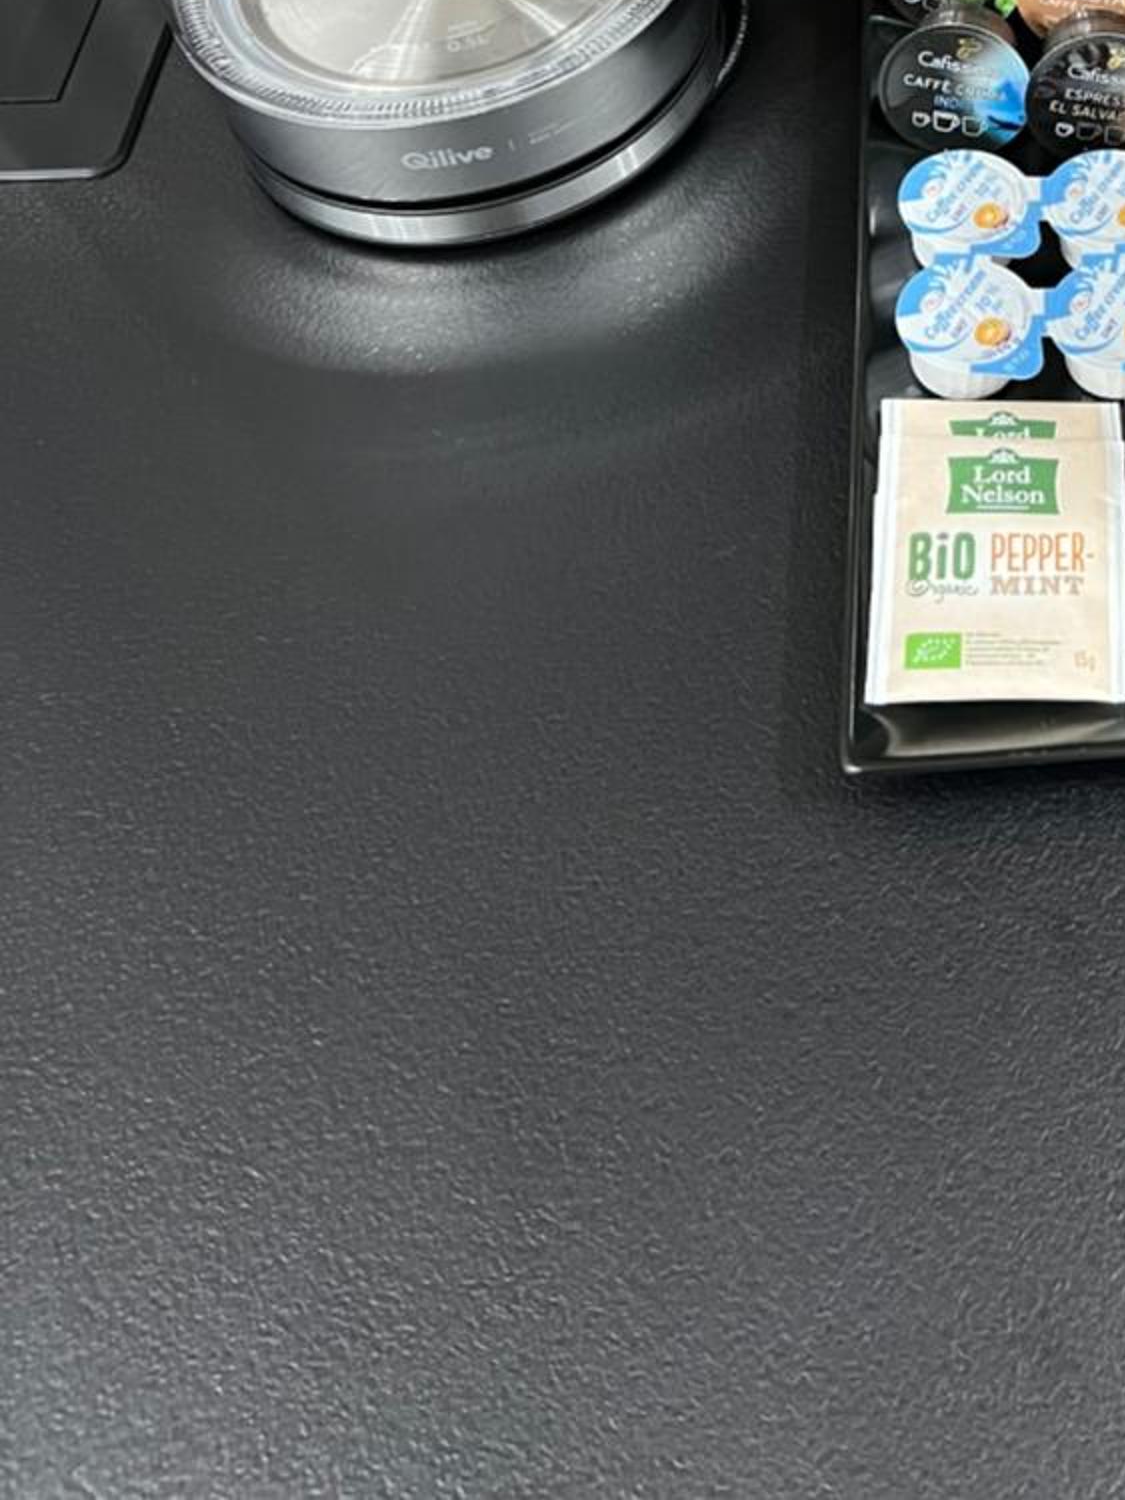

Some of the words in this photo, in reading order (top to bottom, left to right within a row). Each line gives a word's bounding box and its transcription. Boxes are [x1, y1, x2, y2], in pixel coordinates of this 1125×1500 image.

[1048, 100, 1068, 115] EL
[401, 146, 494, 170] Qilive
[973, 465, 1031, 485] Lord
[961, 484, 1045, 505] Nelson
[990, 575, 1085, 596] MINT
